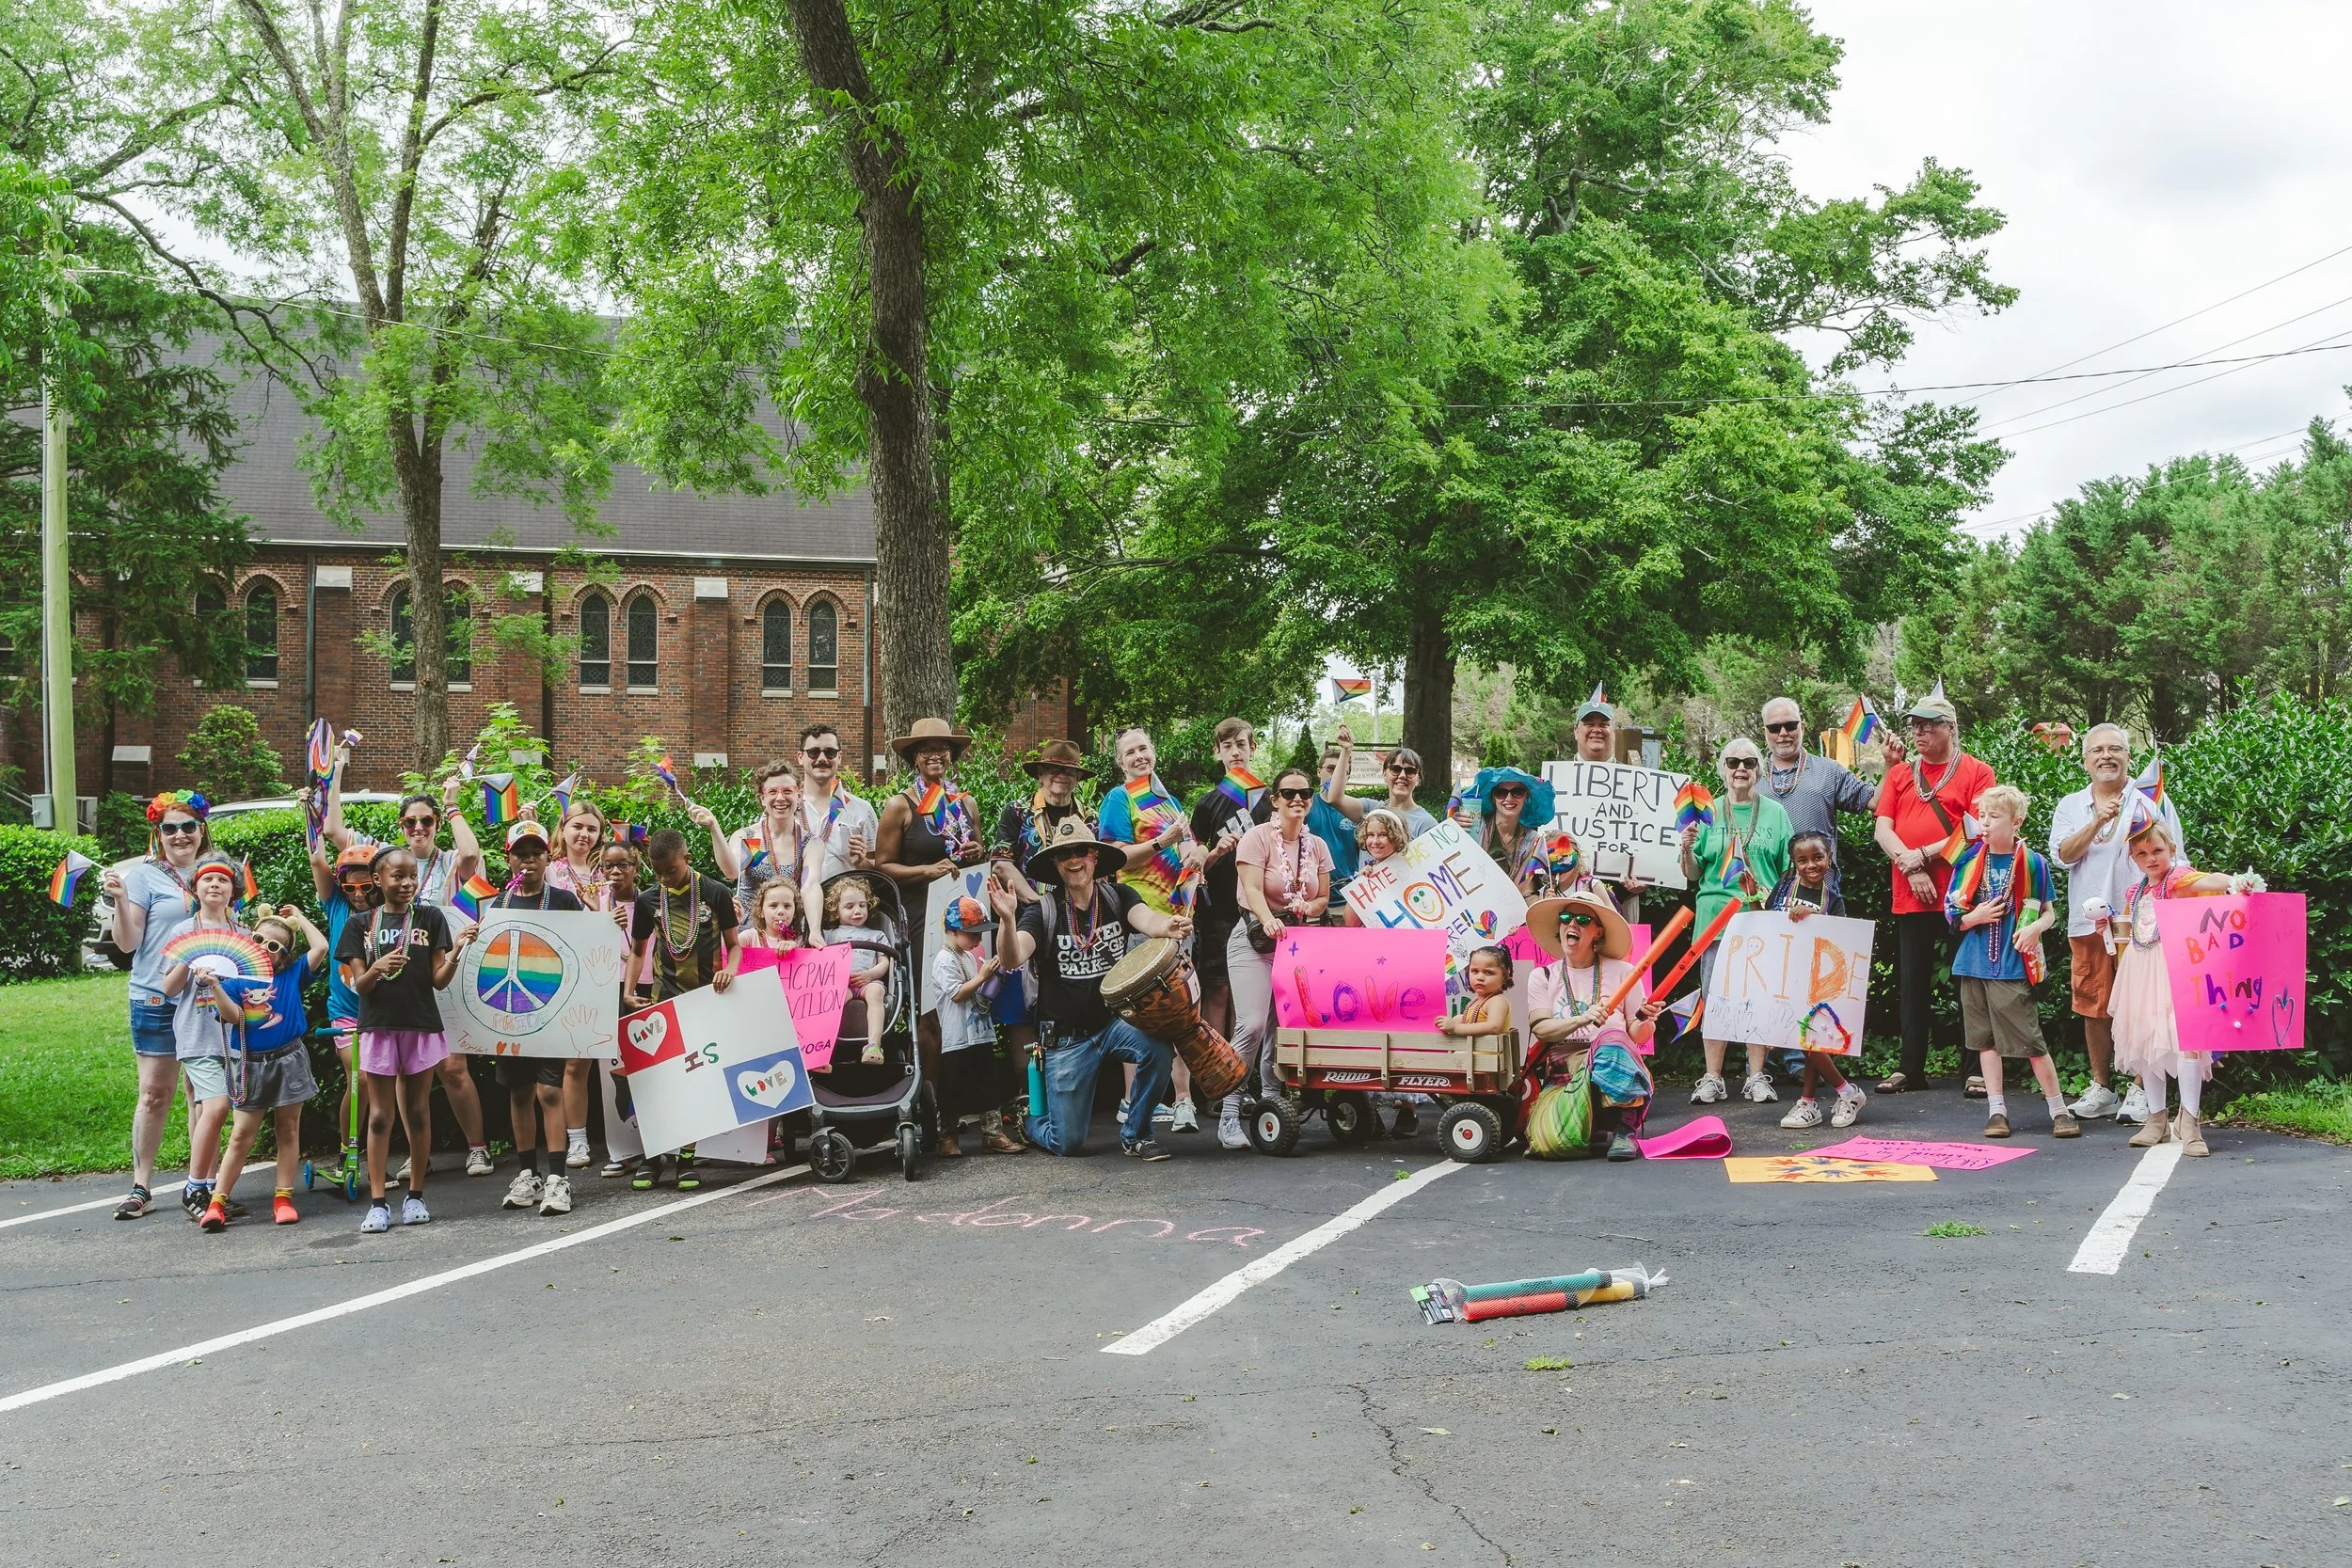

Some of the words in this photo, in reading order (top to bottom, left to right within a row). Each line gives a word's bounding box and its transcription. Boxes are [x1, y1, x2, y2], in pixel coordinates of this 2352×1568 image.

[1549, 762, 1690, 813] LIBERTY
[1554, 812, 1677, 847] JUSTICE
[1349, 866, 1398, 911] HATE
[1403, 841, 1431, 870] HAS
[1429, 822, 1460, 850] NO
[1592, 850, 1664, 885] LL.
[1375, 850, 1485, 929] HOME
[2199, 907, 2247, 934] NO
[1057, 935, 1125, 962] COLLGE
[2185, 932, 2245, 965] BAD
[1058, 958, 1104, 975] PARK
[1723, 932, 1869, 1006] PRIDE
[2189, 971, 2263, 1010] Thing
[491, 1010, 548, 1032] PRIDE
[684, 1041, 720, 1073] IS
[744, 1070, 787, 1098] LOVE
[1322, 1070, 1371, 1083] RADIO
